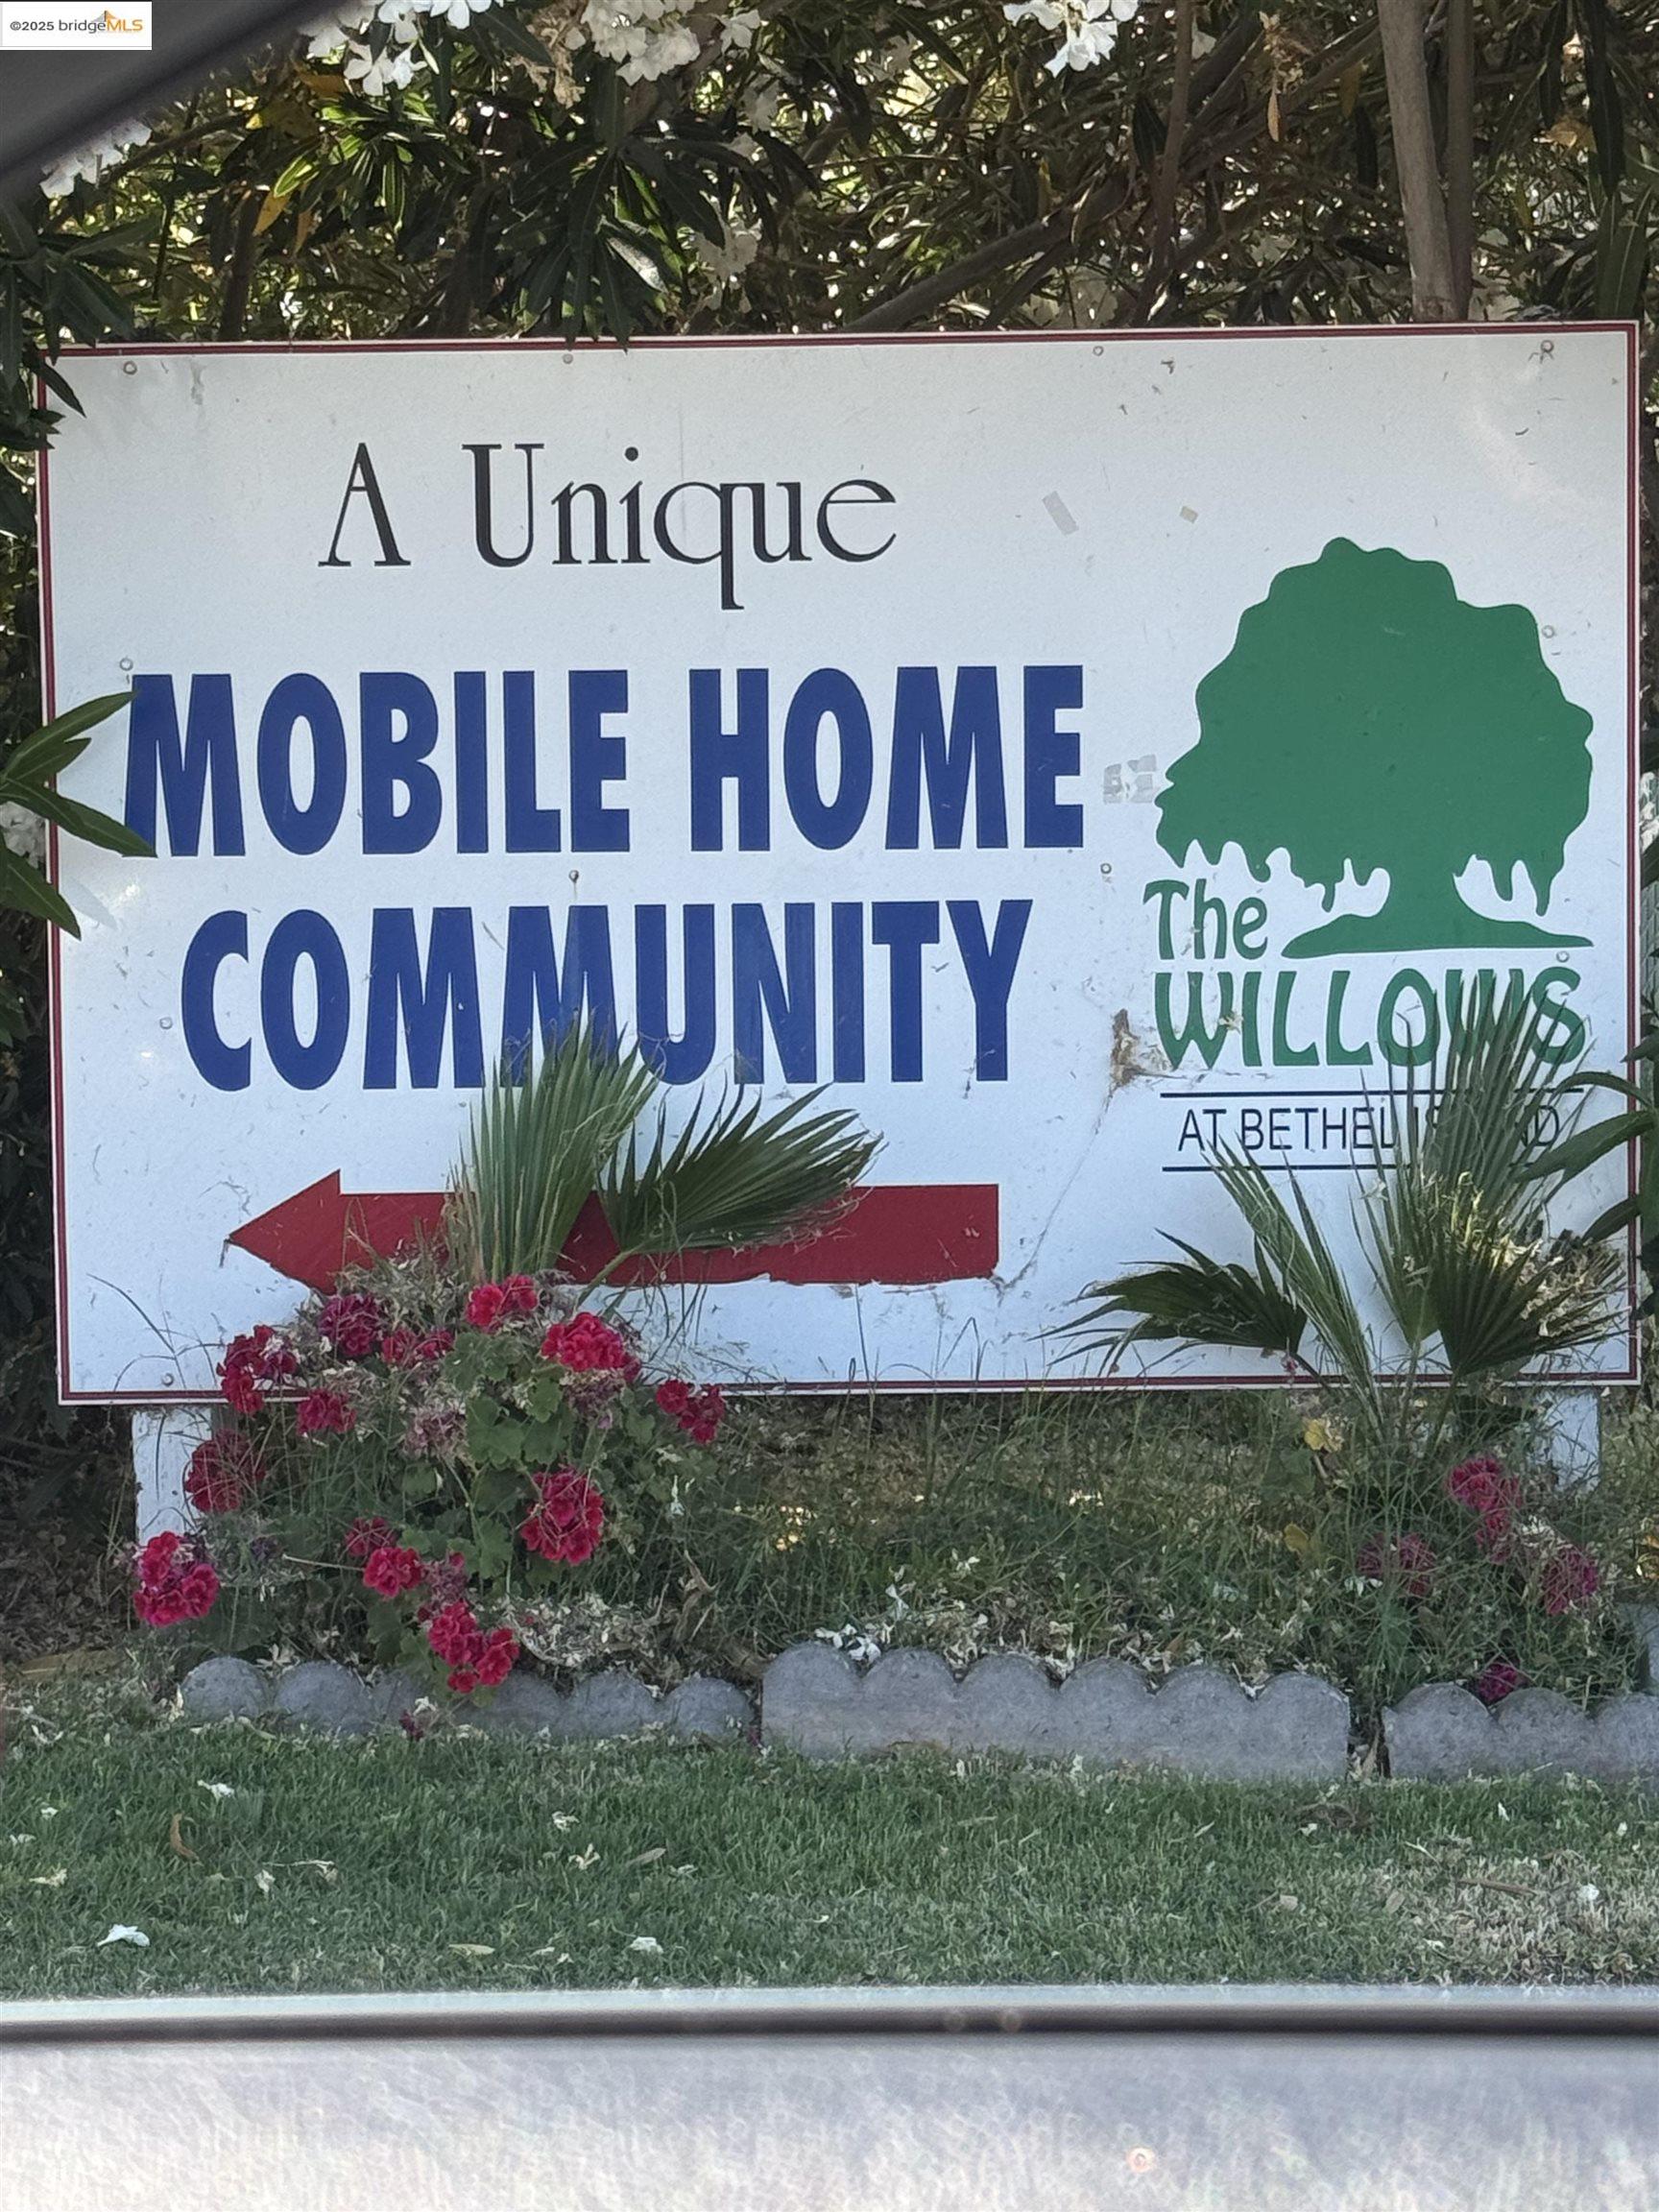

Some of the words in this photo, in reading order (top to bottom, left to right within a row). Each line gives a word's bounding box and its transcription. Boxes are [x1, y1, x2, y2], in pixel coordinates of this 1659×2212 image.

[318, 442, 412, 567] A
[461, 442, 897, 611] Unique
[124, 669, 631, 857] MOBILE
[688, 664, 1084, 852] HOME
[1142, 878, 1269, 961] The
[180, 898, 1034, 1092] COMMUNITY
[1153, 965, 1587, 1070] WILLOWS
[1177, 1107, 1228, 1153] AT
[1240, 1106, 1397, 1151] BETHEL
